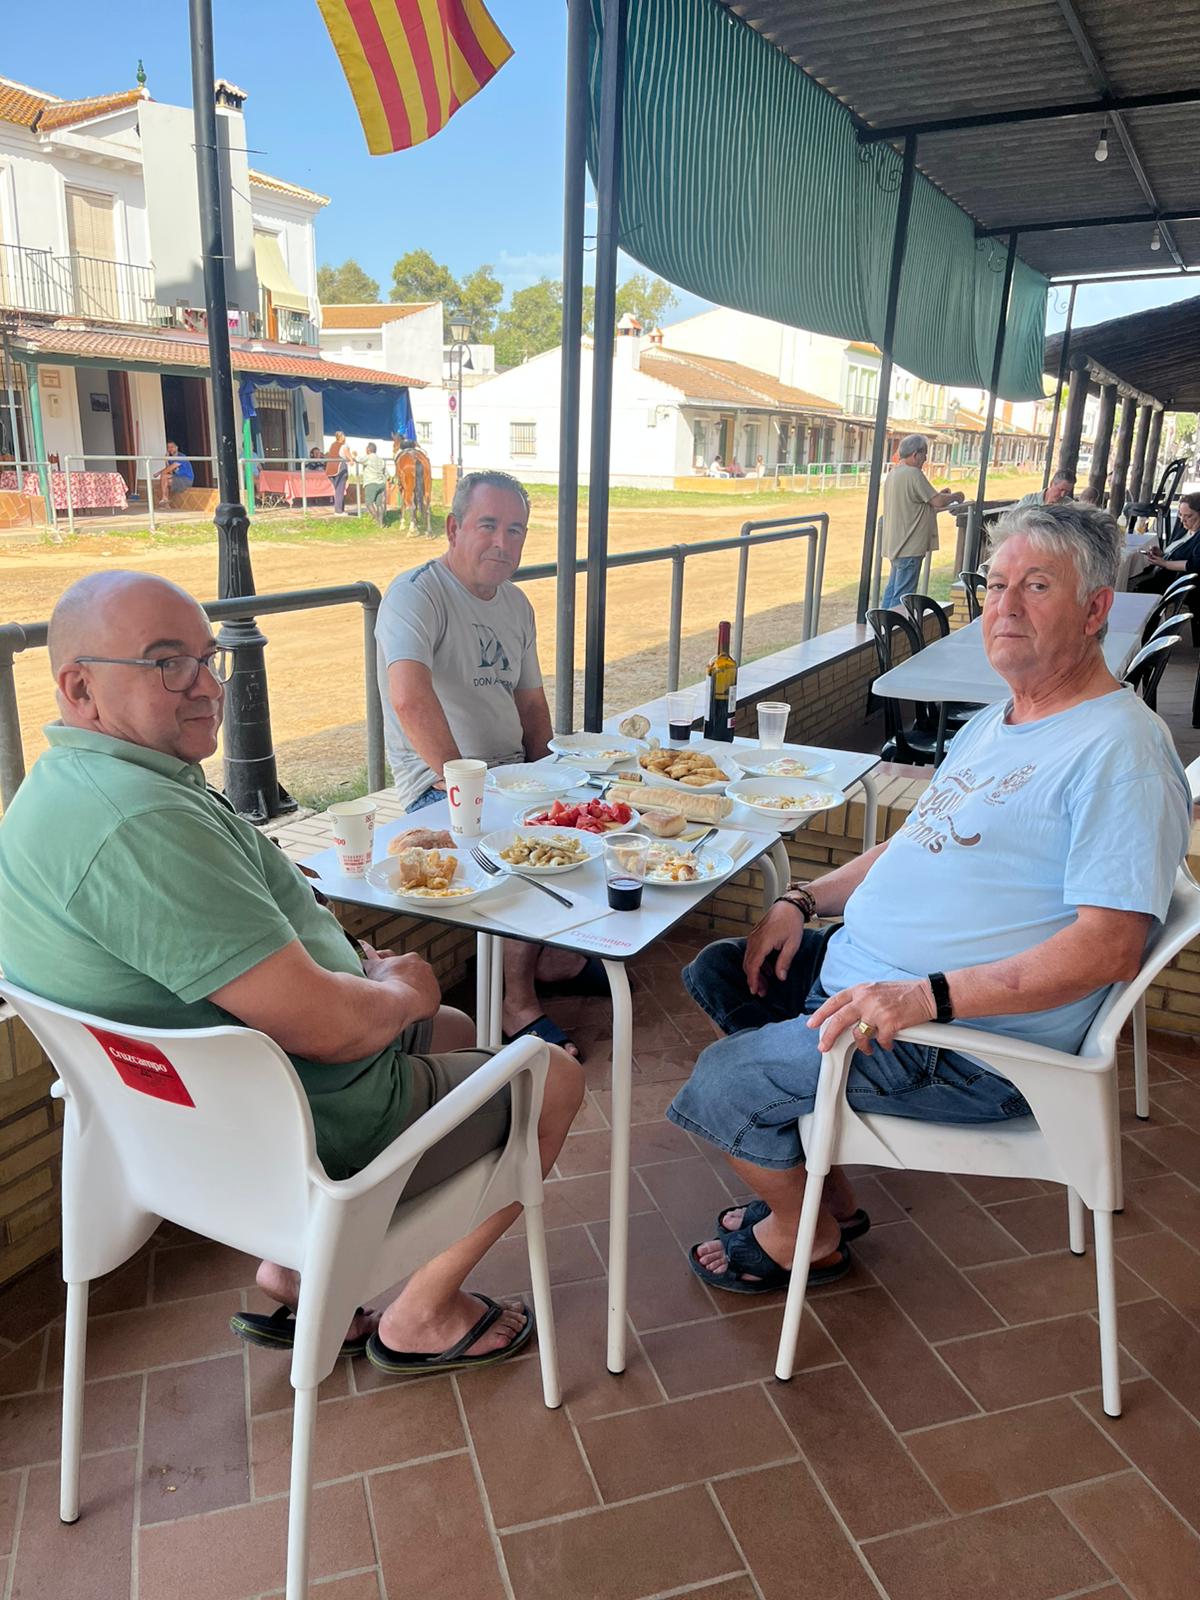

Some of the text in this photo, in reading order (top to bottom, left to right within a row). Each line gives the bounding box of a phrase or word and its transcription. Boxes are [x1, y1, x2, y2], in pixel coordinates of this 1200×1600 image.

[473, 677, 492, 687] DON
[449, 785, 461, 807] C
[109, 1046, 168, 1073] Cruzcampo
